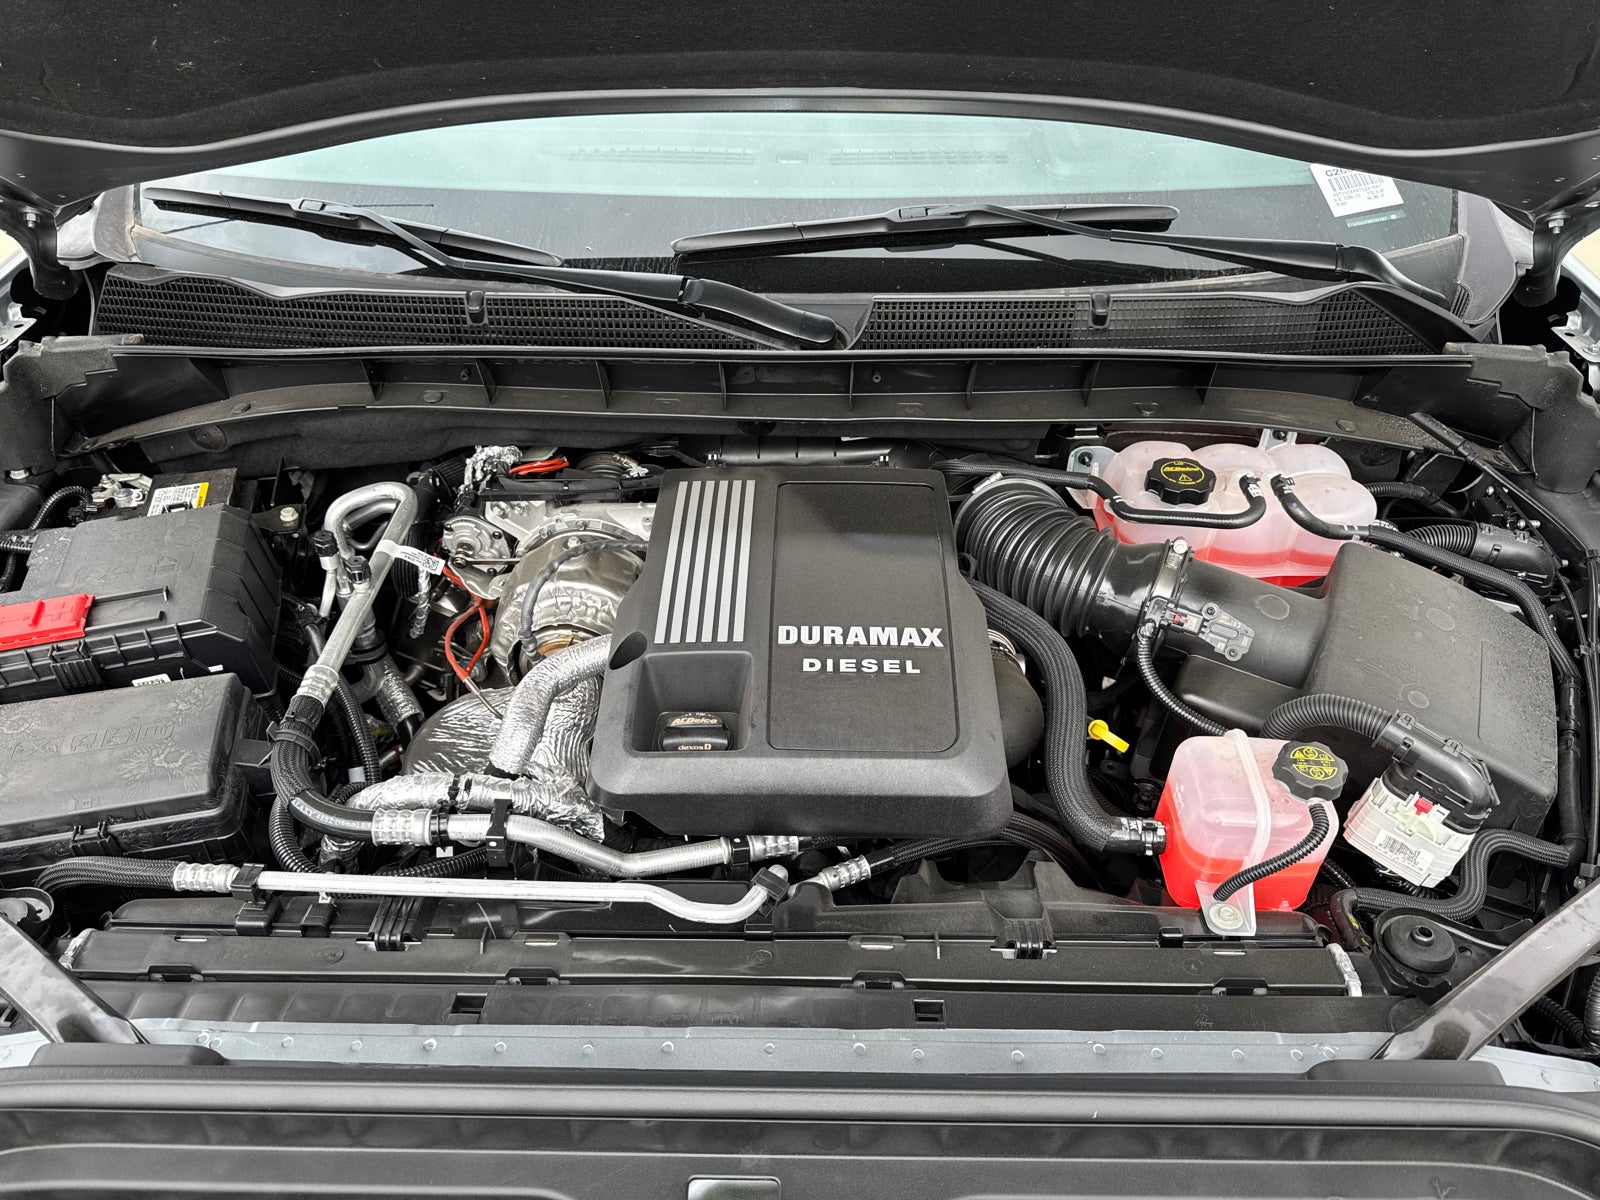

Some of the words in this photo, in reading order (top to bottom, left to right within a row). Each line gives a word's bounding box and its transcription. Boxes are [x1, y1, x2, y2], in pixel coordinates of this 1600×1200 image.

[777, 625, 945, 648] DURAMAX
[802, 658, 921, 674] DIESEL
[670, 717, 718, 726] ACDelco
